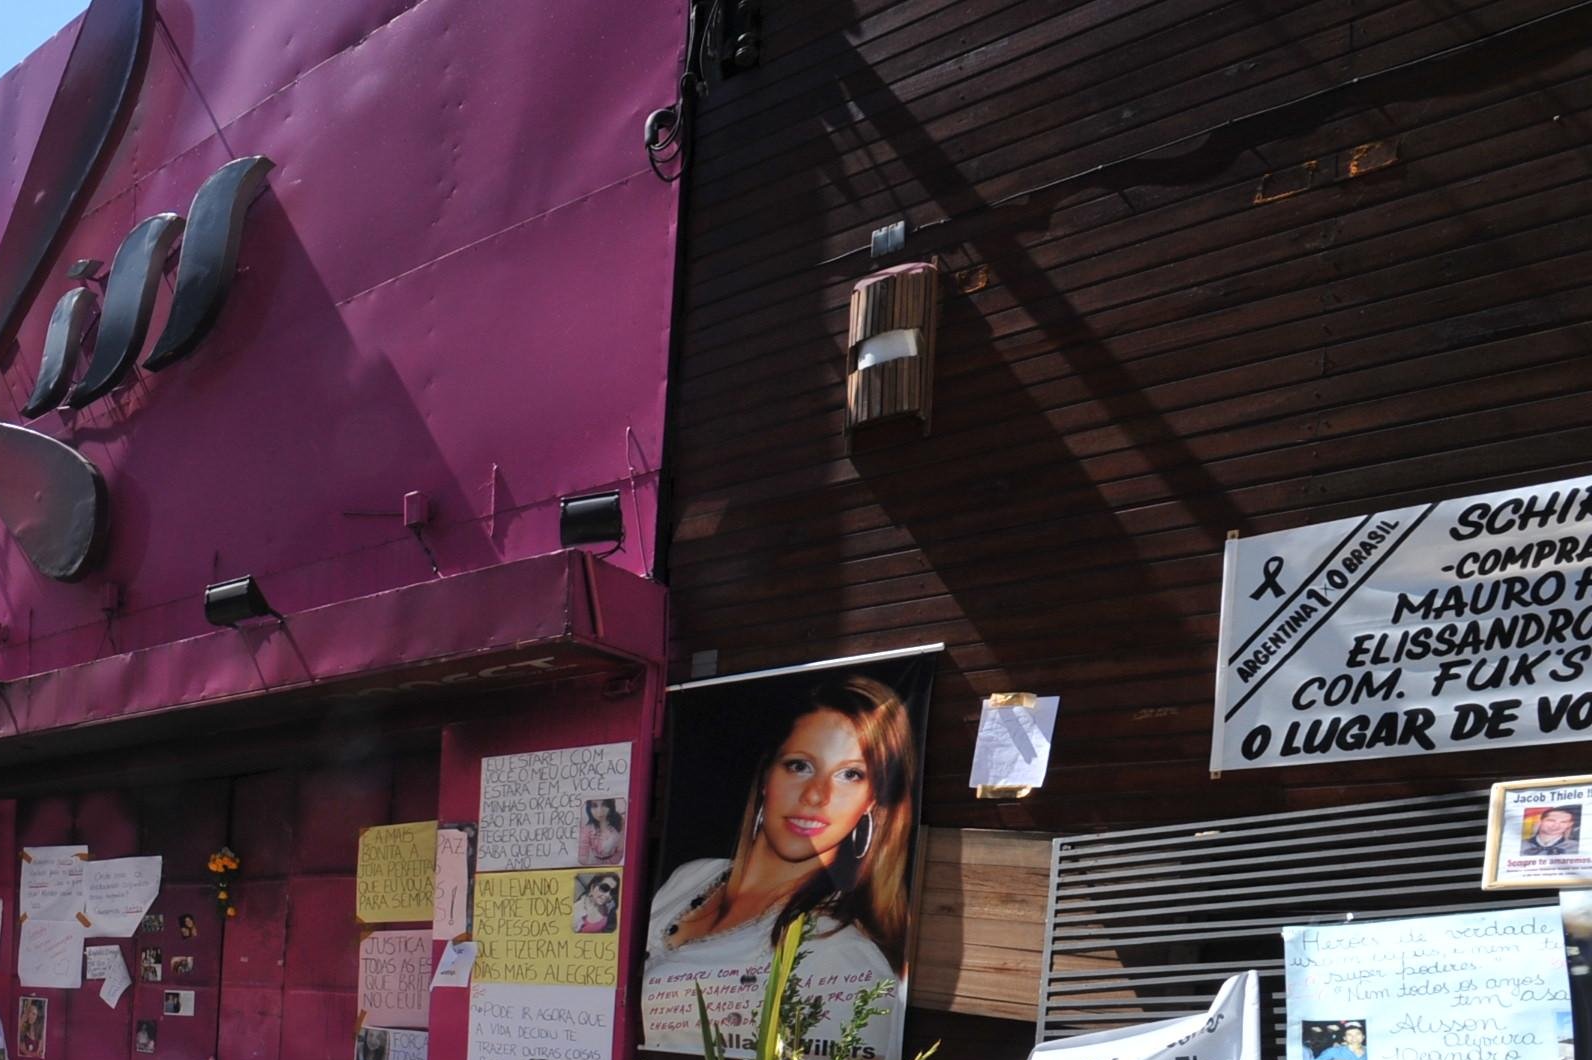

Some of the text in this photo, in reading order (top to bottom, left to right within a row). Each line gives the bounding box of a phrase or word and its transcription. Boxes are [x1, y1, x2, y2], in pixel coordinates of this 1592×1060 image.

[1235, 602, 1318, 683] ARGENTINA
[1341, 518, 1399, 575] BRASIL
[1391, 570, 1566, 625] MAURO
[1345, 606, 1592, 669] ELISSANDRO
[1291, 668, 1406, 711] COM.
[1240, 724, 1272, 761] O
[1280, 707, 1436, 758] LUGAR
[1450, 699, 1522, 741] DE
[486, 749, 605, 772] EU ESTAREI COM
[518, 769, 529, 782] O
[530, 766, 558, 781] MEU
[537, 781, 560, 796] EM
[1513, 793, 1546, 803] Jacob
[1549, 789, 1583, 801] Thiele
[482, 798, 527, 814] MINHAS
[509, 812, 531, 827] PRA
[535, 812, 546, 826] TI
[480, 825, 577, 844] TEGER QUERO QUE
[361, 843, 419, 863] BONITA A
[510, 843, 534, 858] QUE
[535, 842, 551, 857] EU
[504, 857, 532, 870] AMO
[359, 880, 381, 895] QUE
[383, 879, 400, 894] EU
[400, 878, 422, 893] VOU
[479, 877, 559, 898] VAI LEVANDO
[359, 894, 387, 912] PARA
[474, 898, 524, 918] SEMPRE
[528, 896, 573, 916] TODAS
[477, 918, 560, 937] AS PESSOAS
[1446, 917, 1555, 941] verdade
[364, 936, 426, 956] JUSTIÇA
[506, 939, 569, 960] FIZERAM
[574, 940, 617, 961] SEUS
[361, 957, 397, 975] TODAS
[400, 957, 416, 974] AS
[543, 963, 616, 985] ALEGRES
[365, 975, 389, 992] QUE
[817, 975, 840, 987] EM
[1323, 968, 1387, 986] super
[1396, 982, 1450, 998] todos
[1457, 978, 1476, 993] os
[1485, 974, 1546, 997] anjos
[363, 992, 383, 1009] NO
[649, 1003, 693, 1016] MINHAS
[705, 998, 751, 1014] RAÇÕES
[484, 1002, 607, 1028] PODE IR AGORA QUE
[649, 1017, 689, 1031] CHEGOU
[1389, 1013, 1507, 1035] Alisson
[475, 1023, 484, 1035] A
[490, 1023, 511, 1038] VIDA
[564, 1028, 577, 1041] TE
[475, 1040, 602, 1060] TRAZER OUTRAS COISAS
